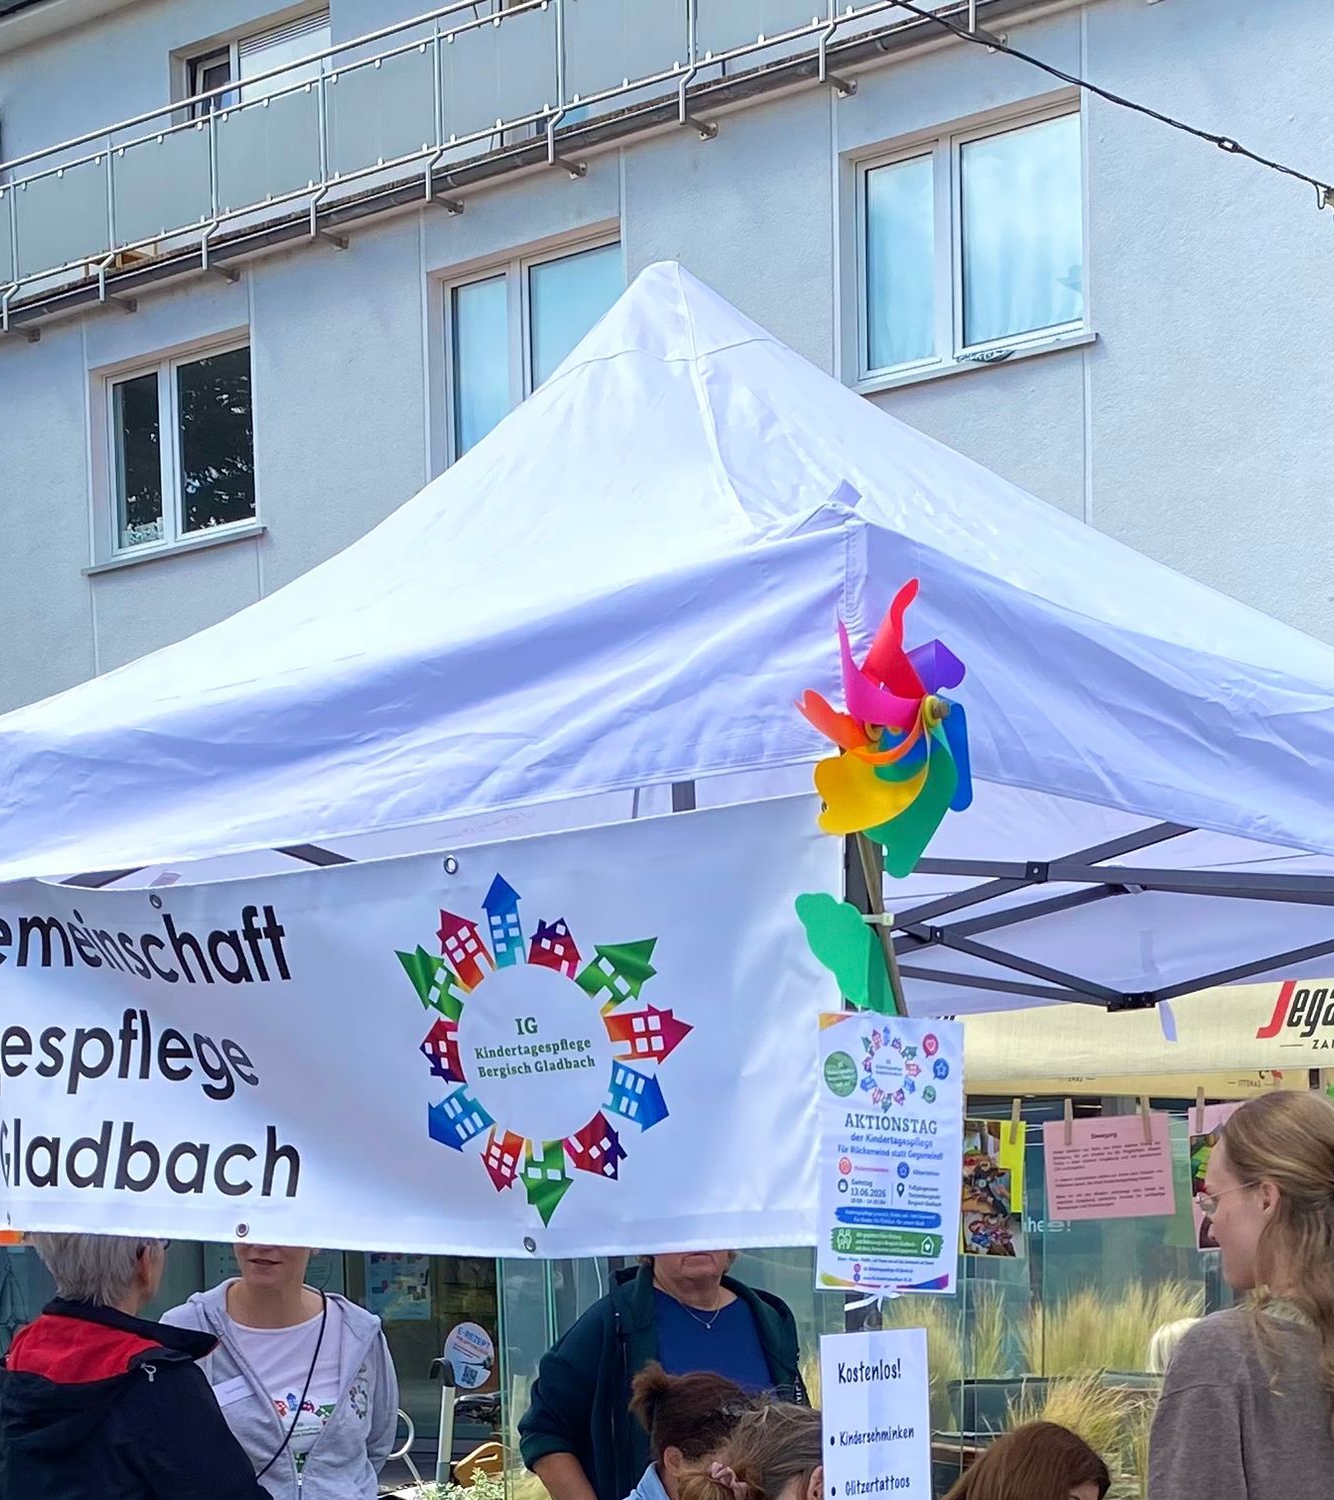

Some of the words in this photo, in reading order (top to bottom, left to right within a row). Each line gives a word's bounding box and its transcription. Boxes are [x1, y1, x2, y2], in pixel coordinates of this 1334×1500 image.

[515, 1017, 538, 1035] IG
[474, 1038, 592, 1059] Kindertagespflege
[477, 1062, 532, 1079] Bergisch
[534, 1055, 596, 1072] Gladbach
[844, 1113, 938, 1135] AKTIONSTAG
[850, 1132, 863, 1142] der
[0, 1118, 301, 1197] Gladbach
[837, 1357, 902, 1384] Kostenlos!
[838, 1425, 915, 1447] Kinderschminken
[845, 1474, 910, 1496] Glitzertattoos
